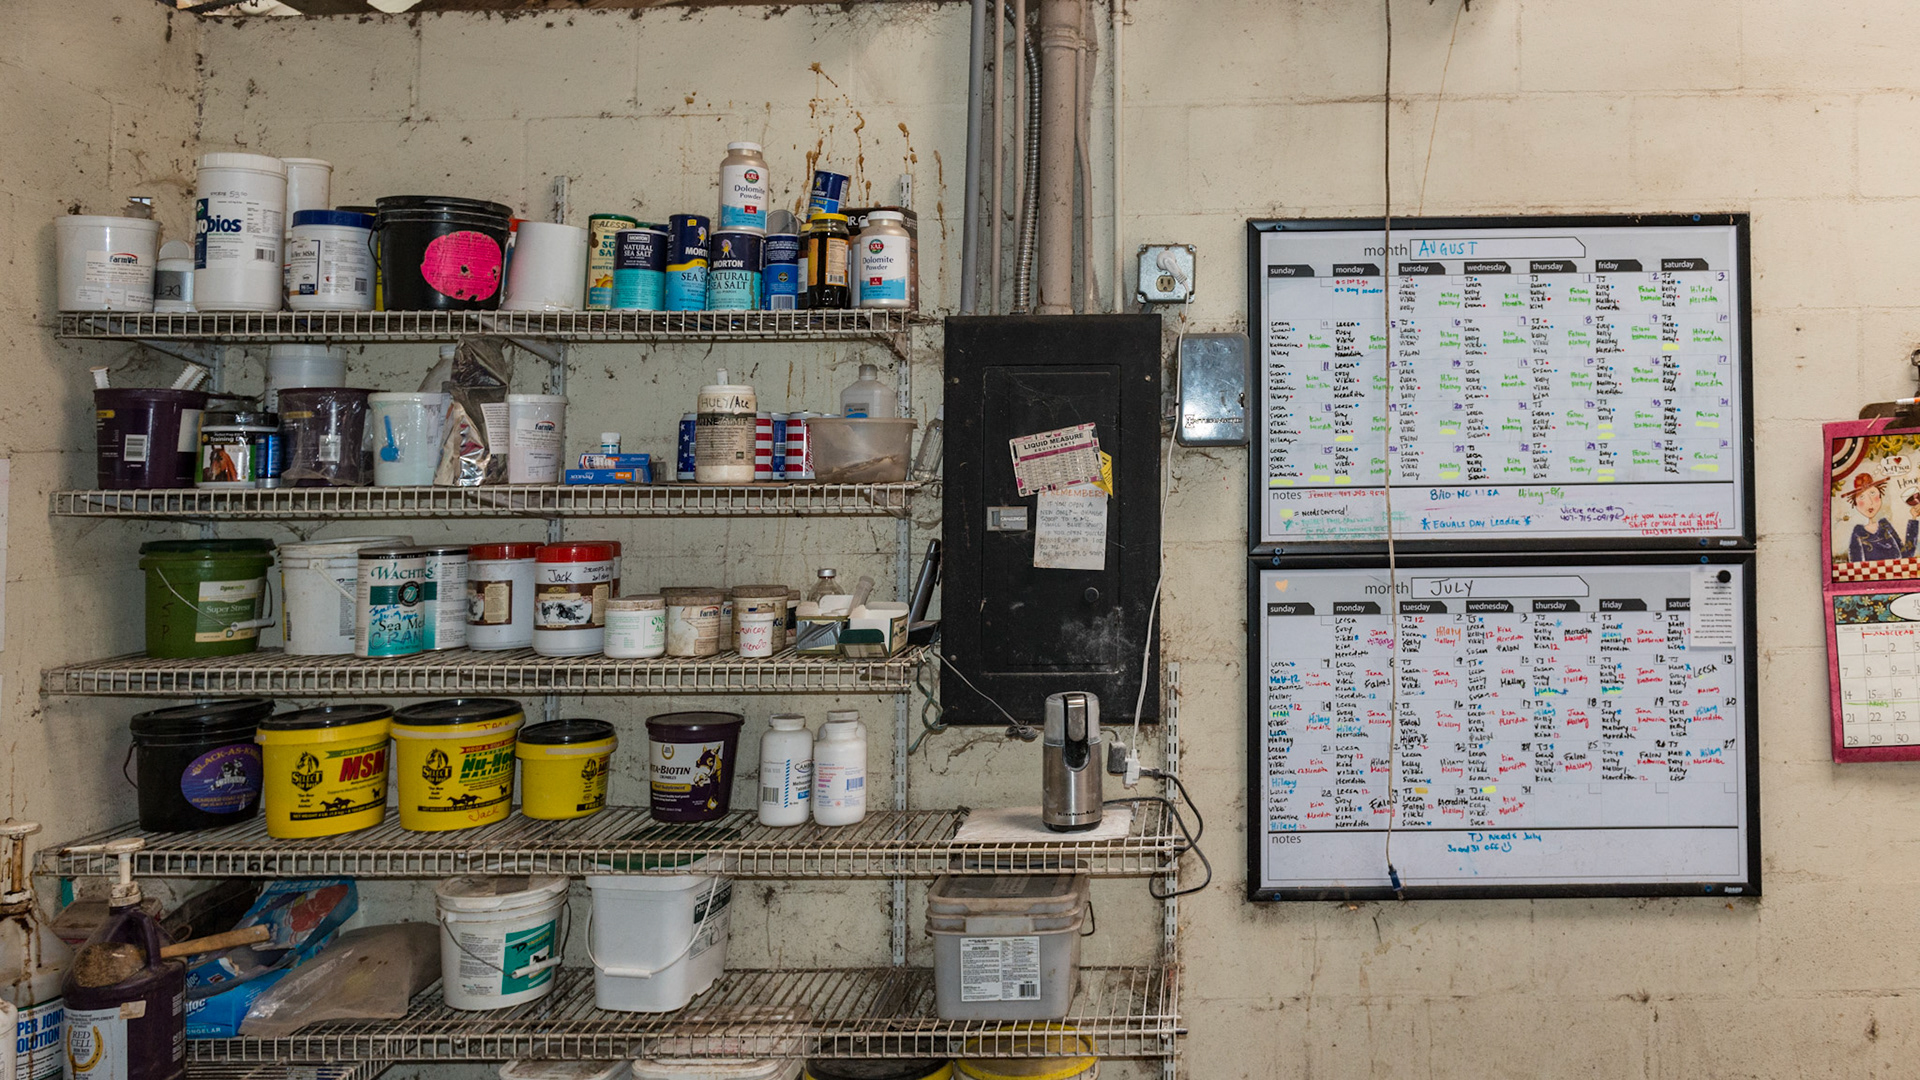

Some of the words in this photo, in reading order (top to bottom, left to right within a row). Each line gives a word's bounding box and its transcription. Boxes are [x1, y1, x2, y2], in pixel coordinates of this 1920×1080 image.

[734, 185, 765, 194] Dolomite
[1364, 244, 1408, 256] month
[1418, 239, 1479, 258] AUGUST
[713, 260, 743, 268] MORTON
[862, 256, 894, 264] Dolomite
[1270, 266, 1296, 275] sunday
[1335, 265, 1364, 274] monday
[1401, 264, 1430, 274] tuesday
[1467, 263, 1506, 272] wednesday
[1532, 262, 1564, 271] thursday
[1598, 261, 1619, 271] friday
[1664, 261, 1695, 270] saturday
[681, 272, 698, 281] SEA
[710, 271, 749, 281] NATURAL
[1718, 271, 1726, 281] 3
[710, 281, 724, 290] SEA
[724, 281, 747, 290] SALT
[1024, 440, 1048, 450] LIQUID
[1049, 433, 1084, 445] MEASURE
[1272, 491, 1302, 500] notes
[548, 569, 575, 583] Jack
[1364, 583, 1409, 595] month
[1430, 578, 1474, 597] JULY
[206, 606, 229, 614] Super
[1270, 605, 1296, 613] sunday
[1336, 604, 1366, 613] monday
[1402, 603, 1431, 612] tuesday
[1469, 602, 1509, 611] wednesday
[1535, 601, 1567, 611] thursday
[1602, 600, 1623, 610] friday
[1890, 643, 1896, 653] 2
[1842, 667, 1848, 677] 7
[1866, 667, 1872, 676] 8
[1891, 665, 1897, 675] 9
[1844, 691, 1852, 700] 14
[1868, 690, 1877, 699] 15
[1893, 688, 1902, 698] 16
[1846, 713, 1856, 723] 21
[1869, 712, 1882, 722] 22
[1895, 711, 1907, 721] 23
[1847, 736, 1859, 745] 28
[1870, 735, 1882, 744] 29
[1896, 733, 1909, 743] 30
[341, 748, 362, 756] JOINT
[339, 749, 386, 782] MSM
[1271, 833, 1302, 845] notes
[1523, 832, 1542, 842] July
[17, 1018, 38, 1036] PER
[41, 1008, 64, 1030] JOINT
[186, 1027, 221, 1035] ONGELAR
[17, 1026, 60, 1053] OLUTION
[71, 1039, 92, 1047] CELL
